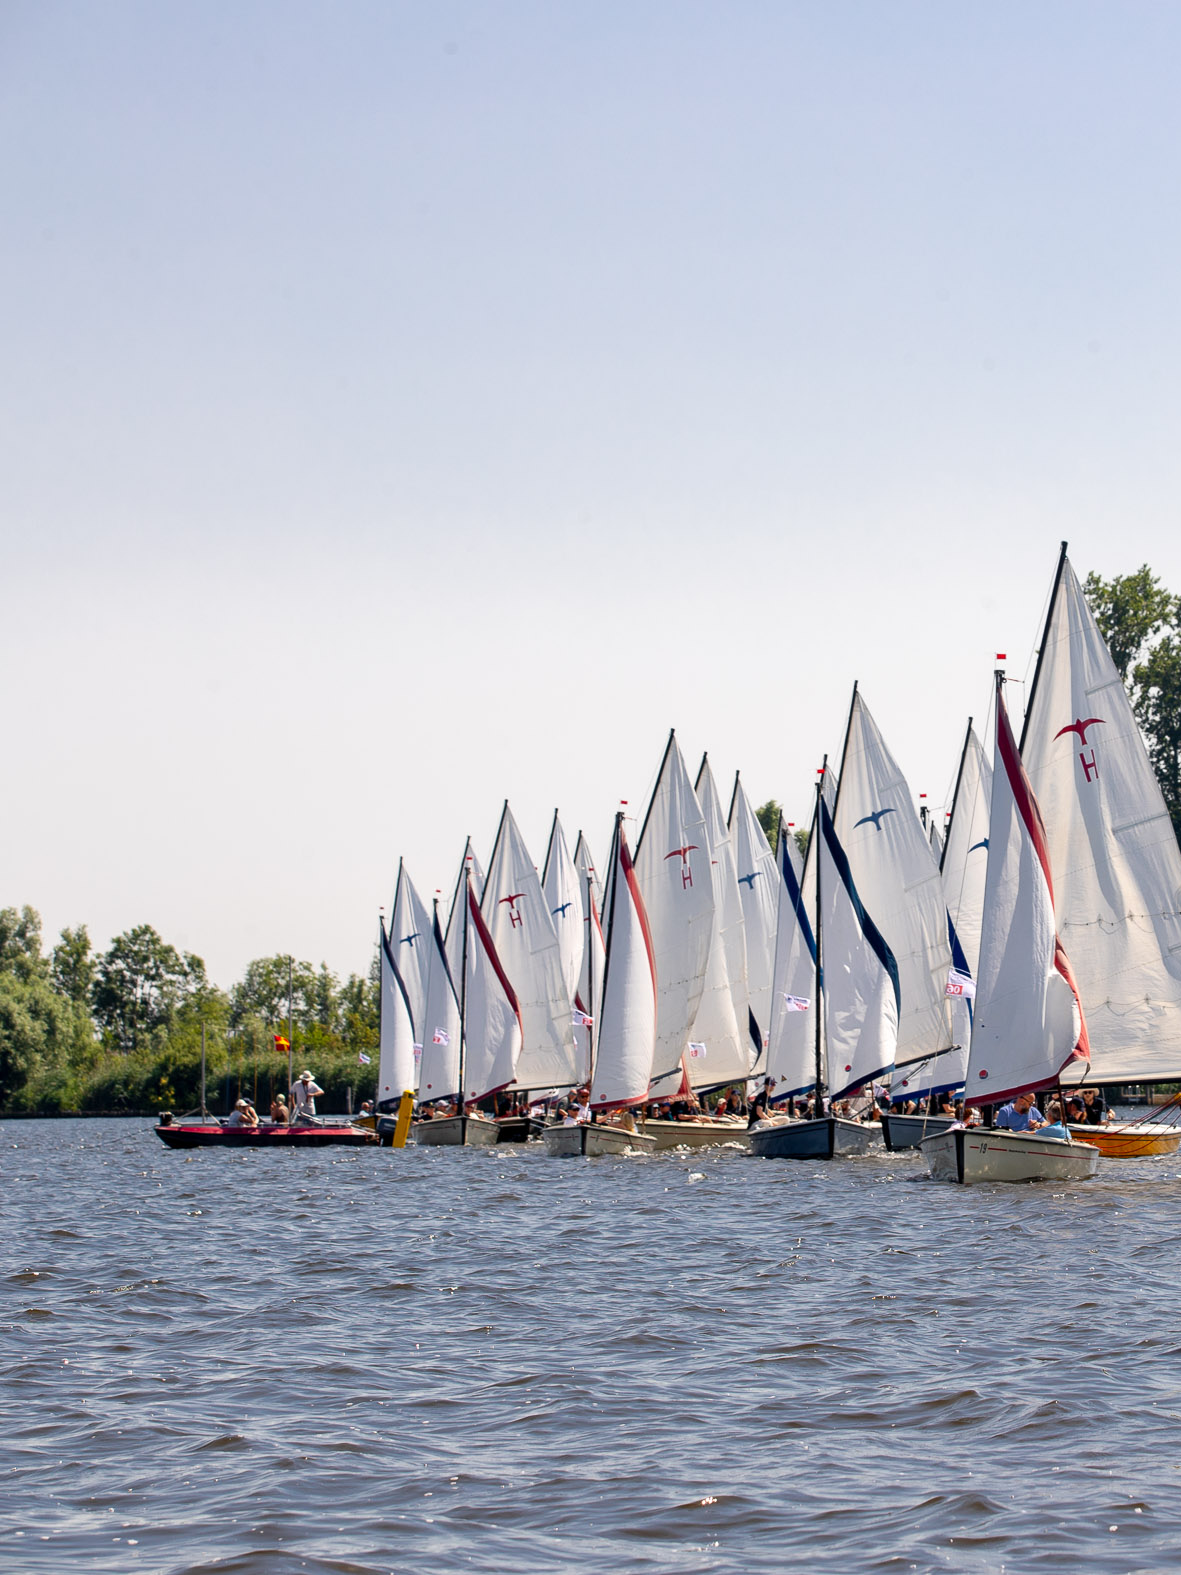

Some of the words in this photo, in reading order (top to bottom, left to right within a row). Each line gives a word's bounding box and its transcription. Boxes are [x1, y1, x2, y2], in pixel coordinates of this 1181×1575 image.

[1079, 749, 1099, 783] H
[681, 866, 693, 890] H
[509, 909, 523, 929] H
